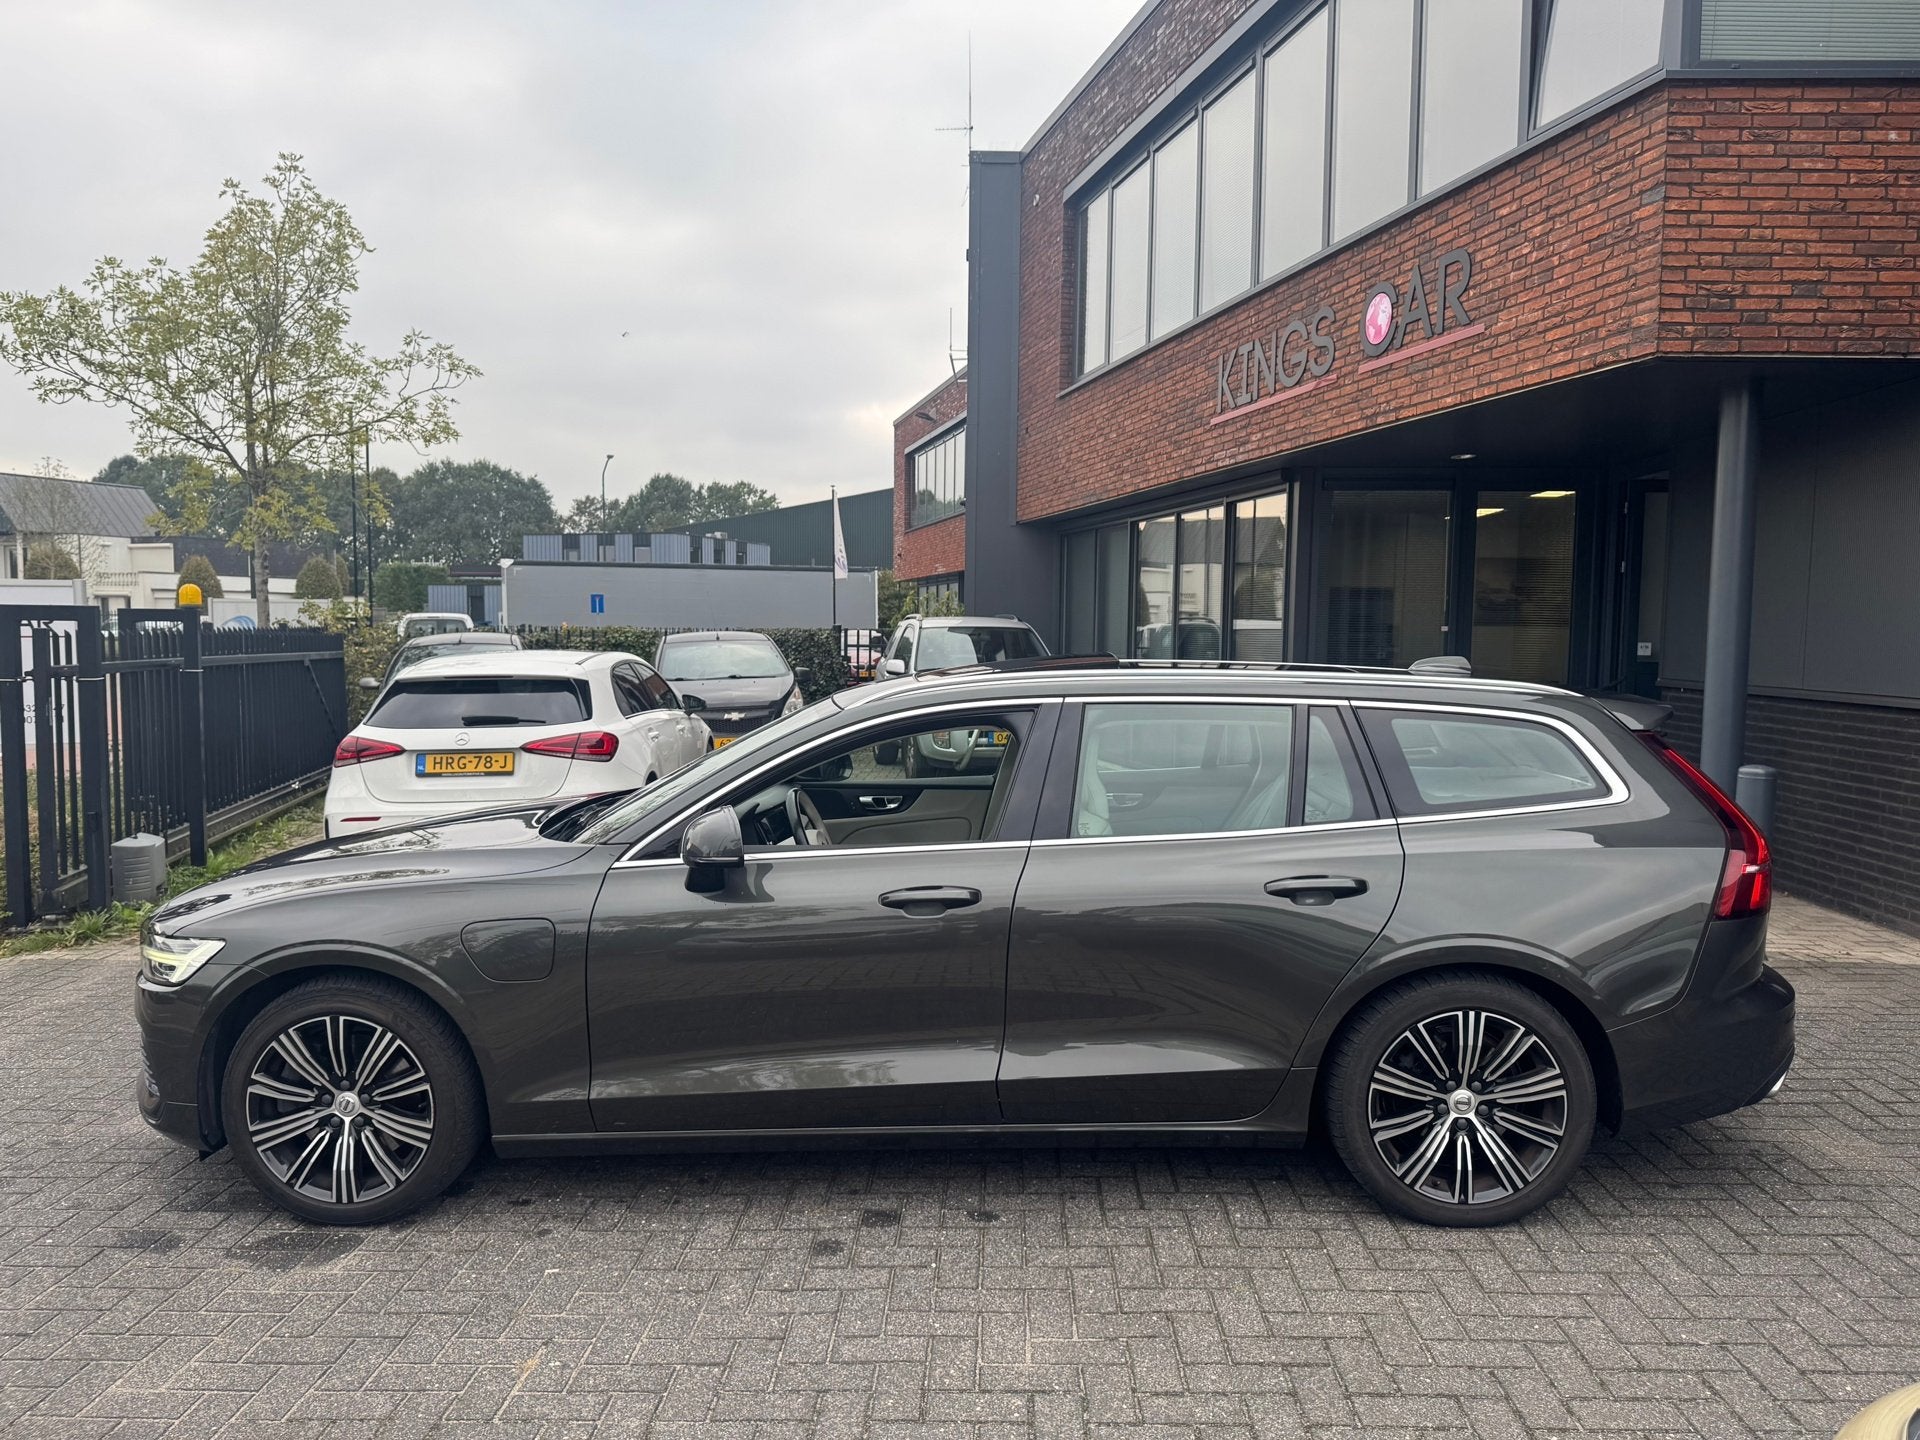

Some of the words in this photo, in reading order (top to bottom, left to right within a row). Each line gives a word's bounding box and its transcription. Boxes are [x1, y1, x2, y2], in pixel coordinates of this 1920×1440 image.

[1216, 306, 1336, 413] KINGS
[1359, 249, 1473, 357] CAR
[432, 755, 508, 770] HRG-78-J
